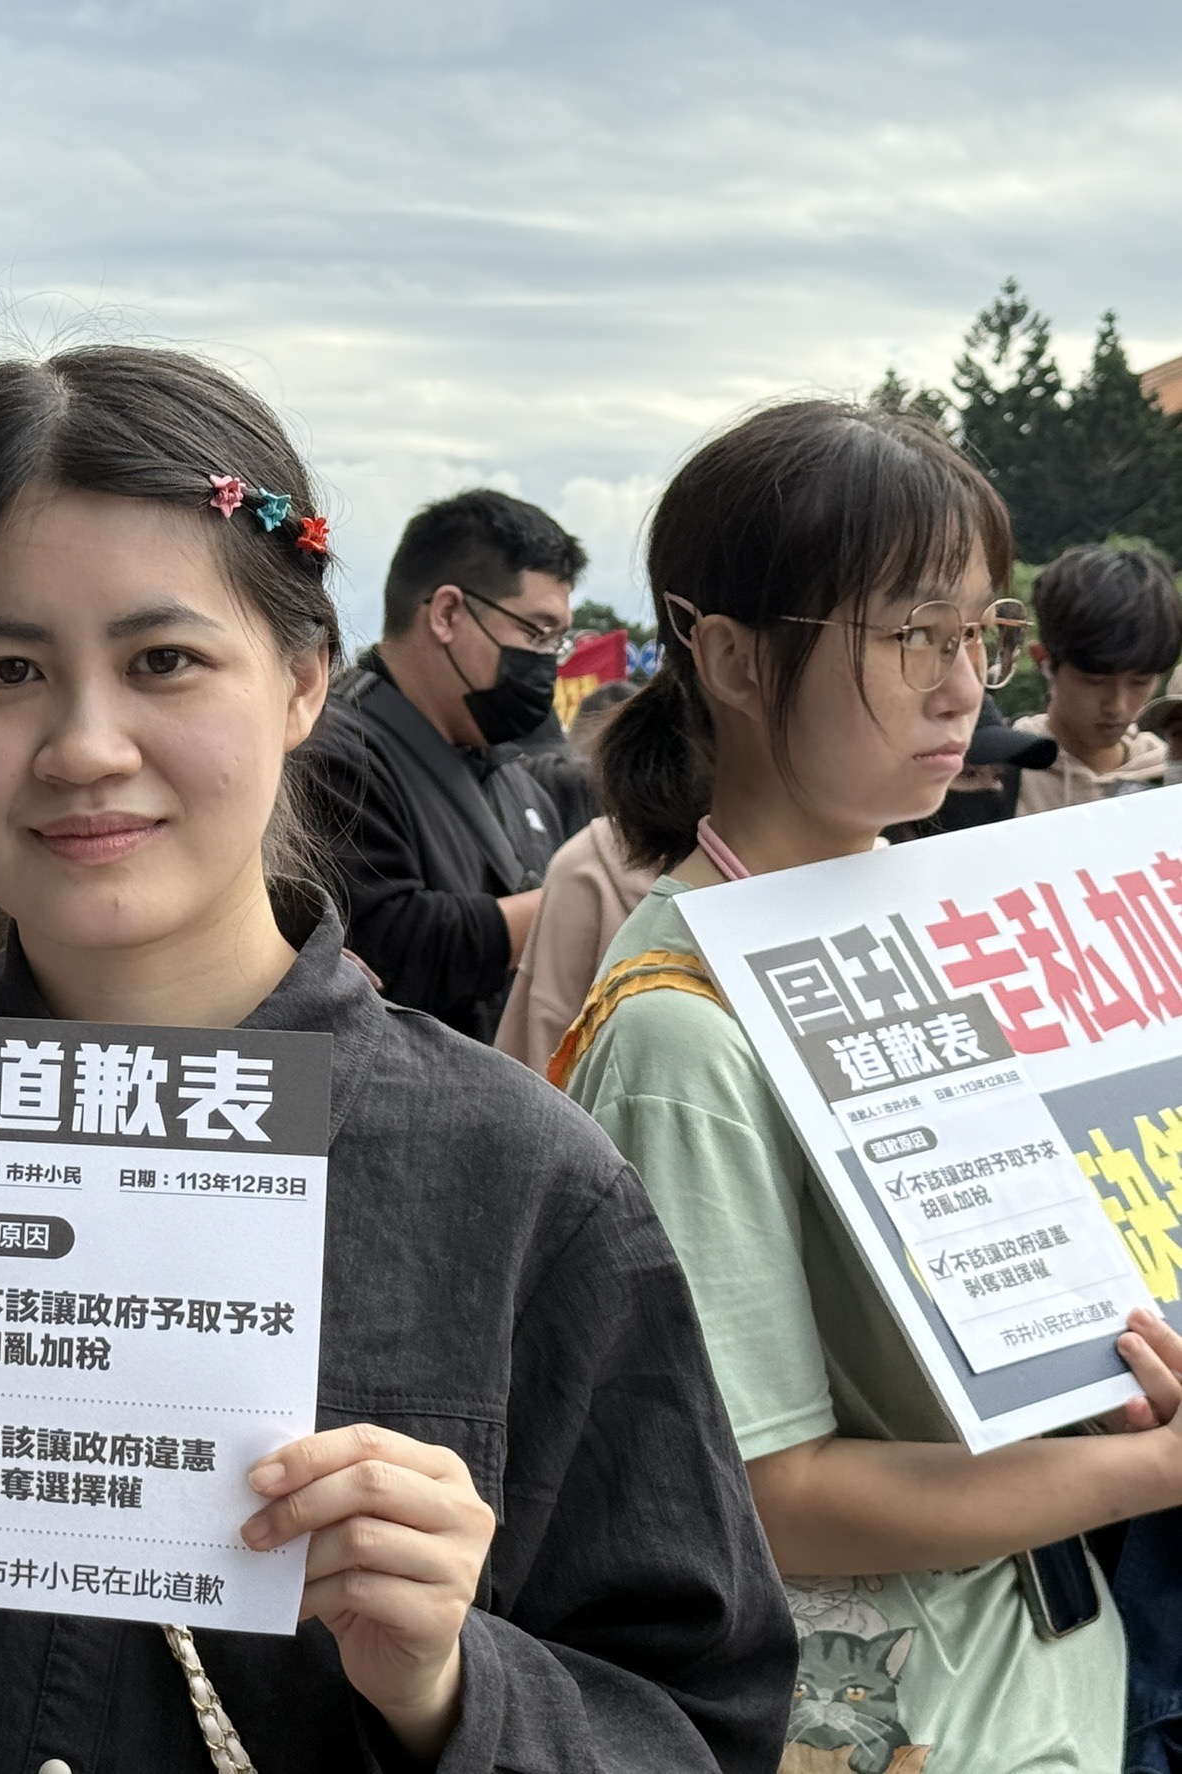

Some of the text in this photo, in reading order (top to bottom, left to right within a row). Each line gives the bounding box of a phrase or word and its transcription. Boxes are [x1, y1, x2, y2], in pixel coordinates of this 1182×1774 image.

[826, 1011, 990, 1092] 道歉表
[906, 1138, 1060, 1194] 不該讓政府予取予求
[920, 1184, 993, 1219] 胡亂加稅
[949, 1224, 1072, 1274] 不該讓政府違憲
[999, 1299, 1119, 1347] 市井小民在此道歉
